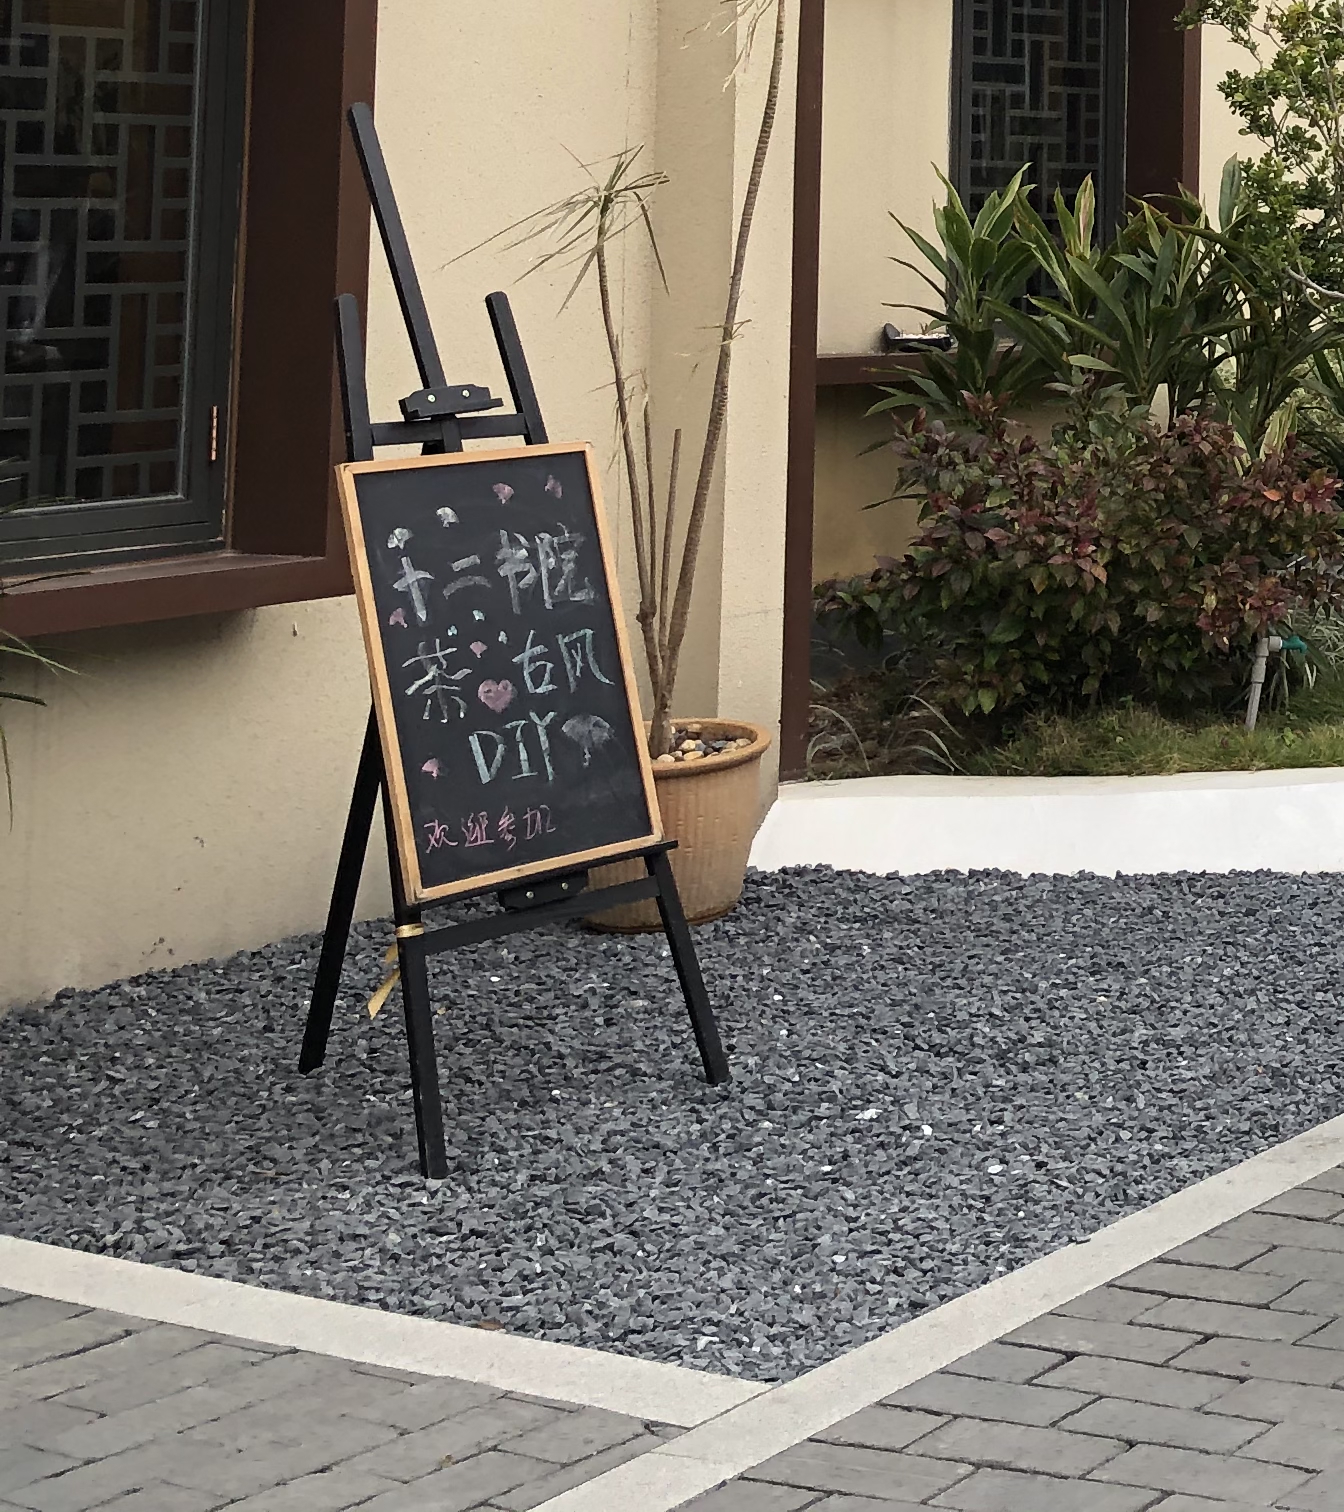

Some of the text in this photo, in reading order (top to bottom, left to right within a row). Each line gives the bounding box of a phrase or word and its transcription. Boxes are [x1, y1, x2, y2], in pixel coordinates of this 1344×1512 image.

[401, 628, 616, 724] 茶 古风
[468, 710, 557, 785] DIY
[423, 804, 557, 854] 欢迎参加
